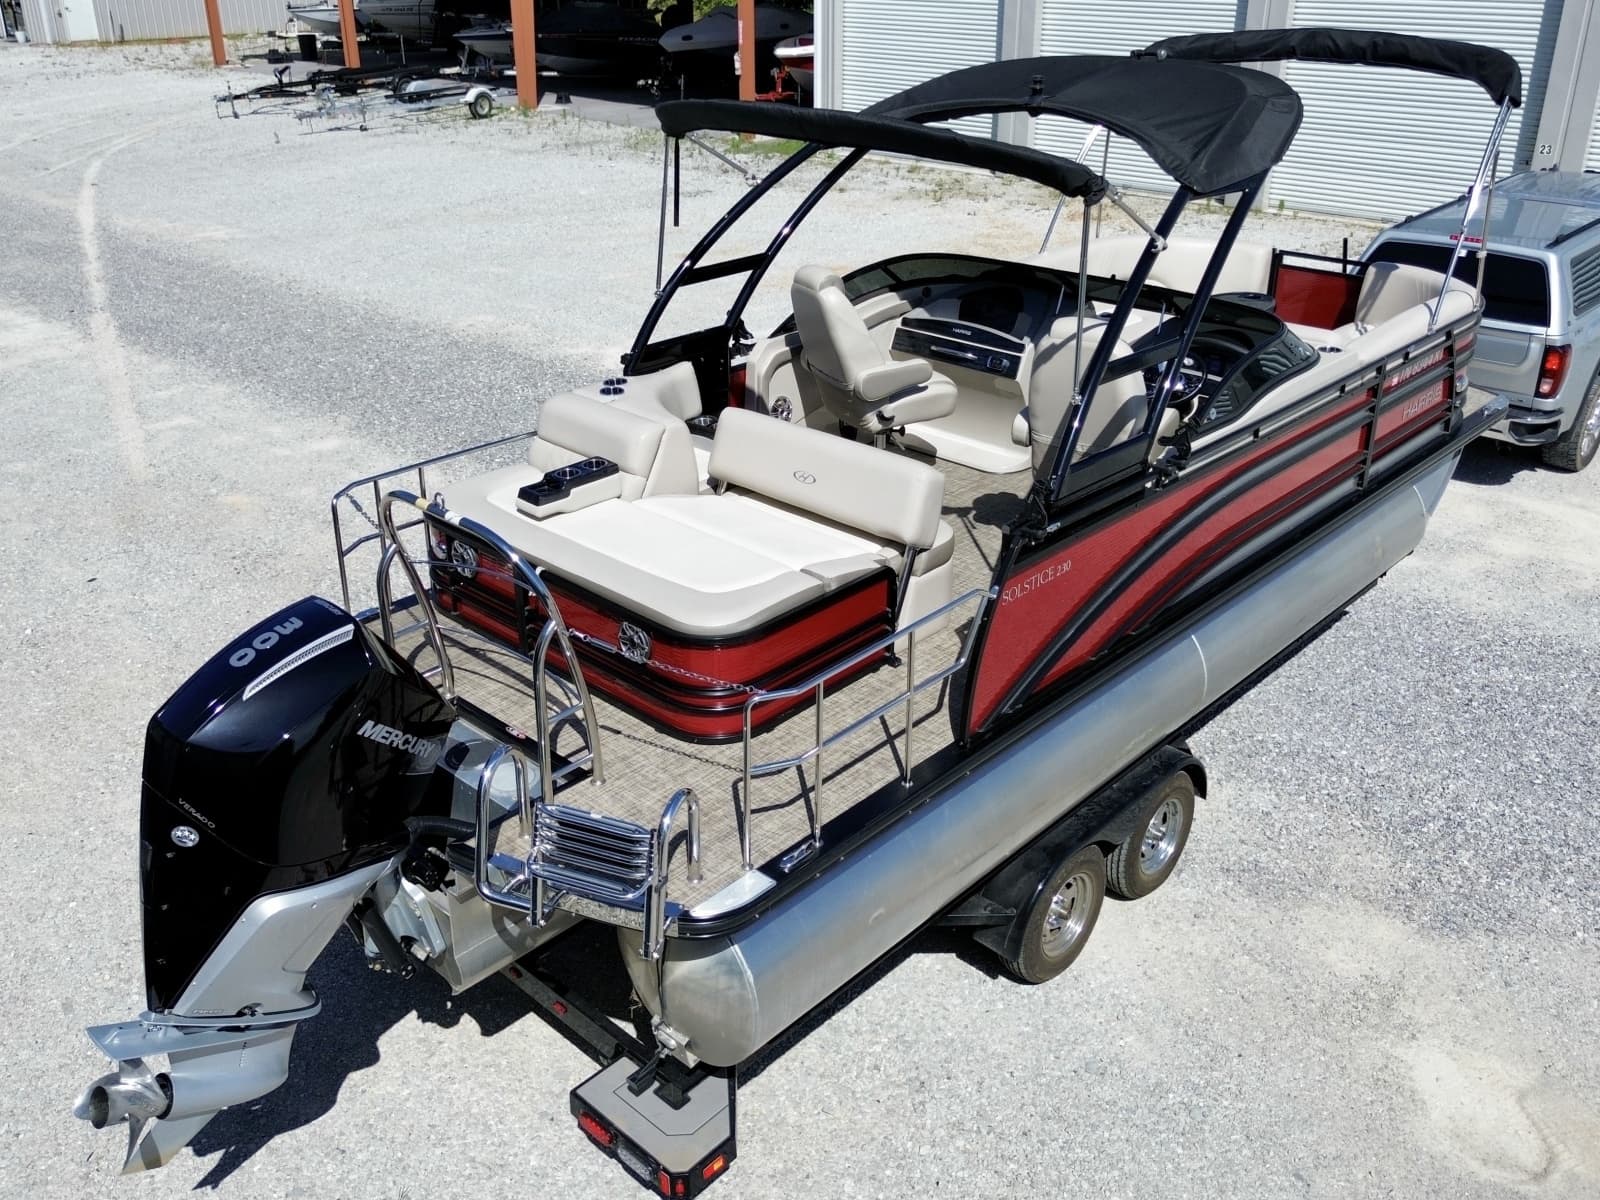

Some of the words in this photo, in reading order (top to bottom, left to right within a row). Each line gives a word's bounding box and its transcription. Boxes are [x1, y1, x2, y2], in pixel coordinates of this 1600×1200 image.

[1539, 144, 1552, 155] 23
[1001, 566, 1055, 606] SOLSTICE
[1056, 559, 1072, 577] 230
[229, 616, 304, 668] 300
[356, 719, 438, 758] MERCURY
[178, 797, 216, 829] VERADO
